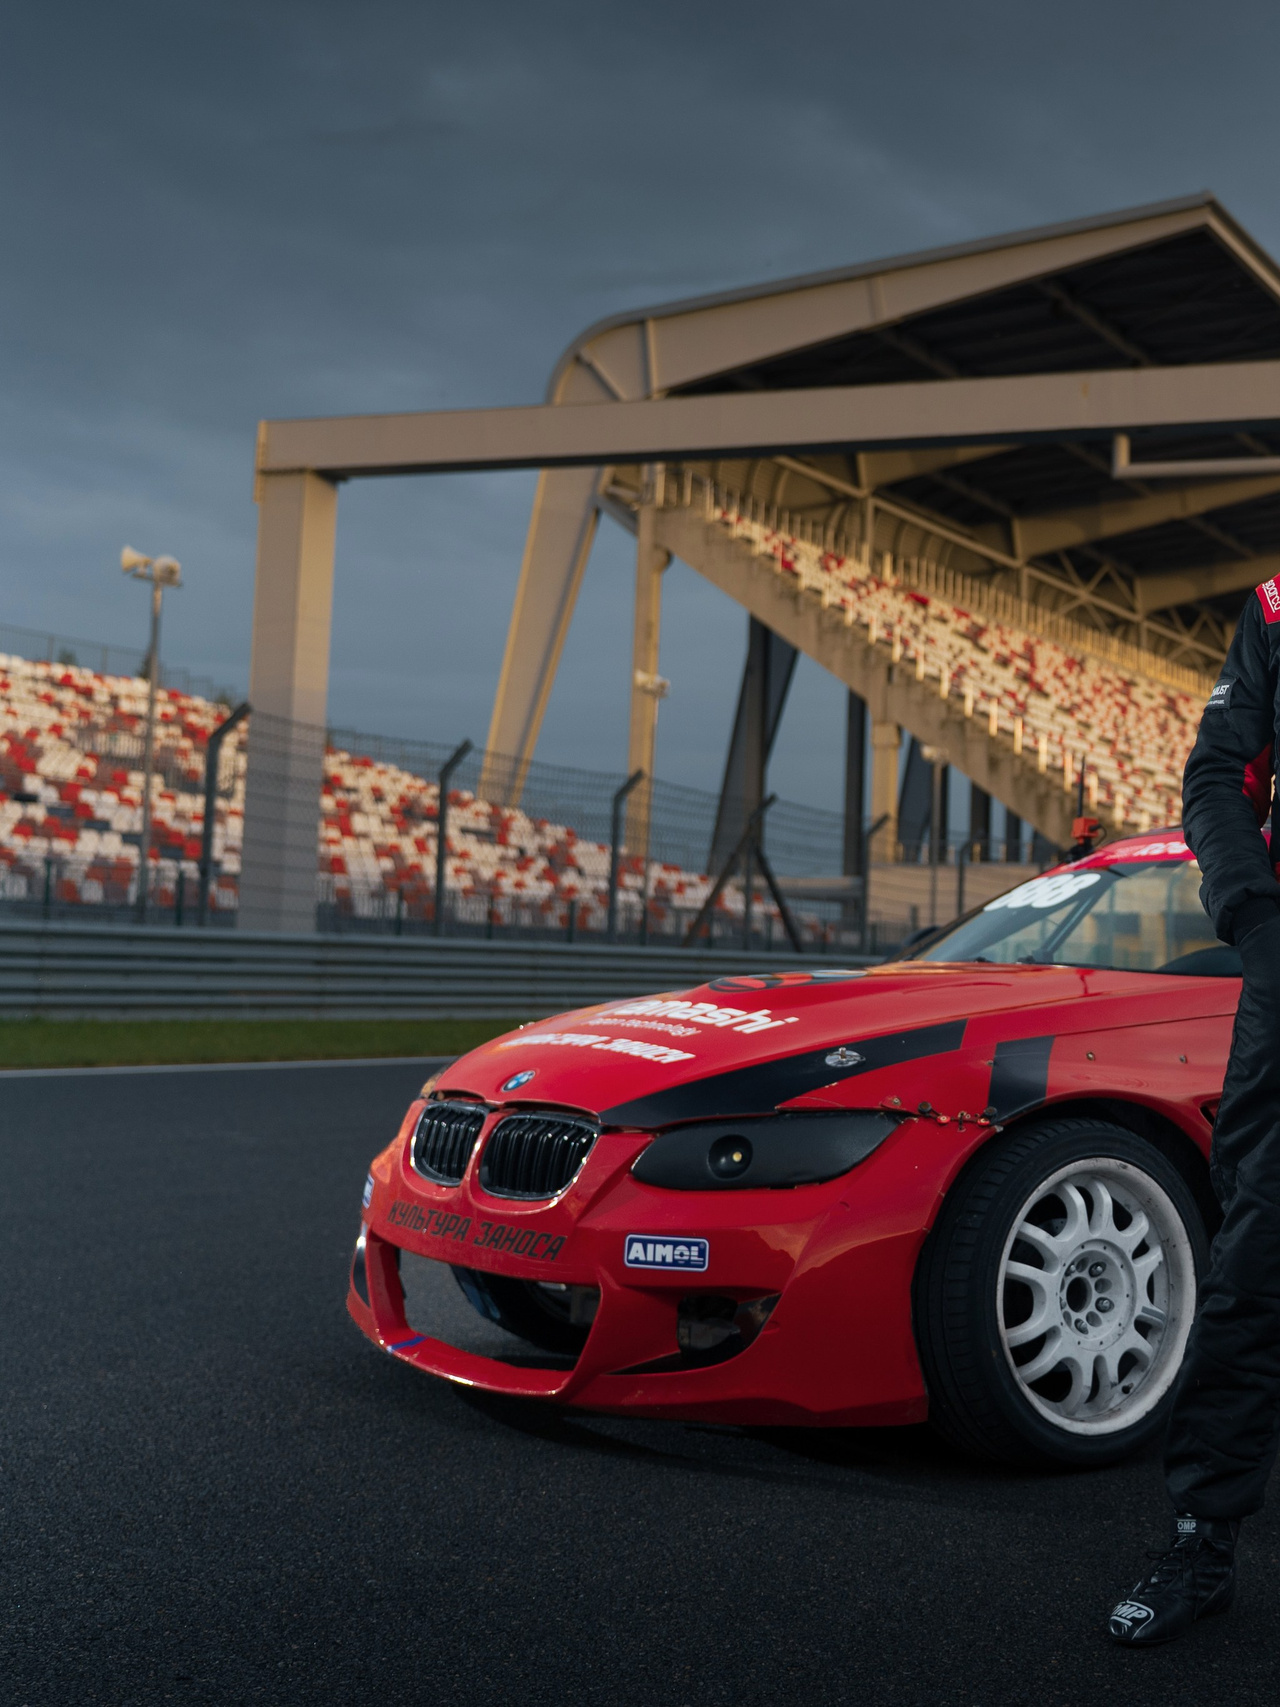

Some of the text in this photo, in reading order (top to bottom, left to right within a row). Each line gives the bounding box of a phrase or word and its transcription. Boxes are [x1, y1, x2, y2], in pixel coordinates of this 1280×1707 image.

[386, 1200, 568, 1262] КУЛЬТУРА ЗАНОСА
[1177, 1521, 1197, 1531] OMP
